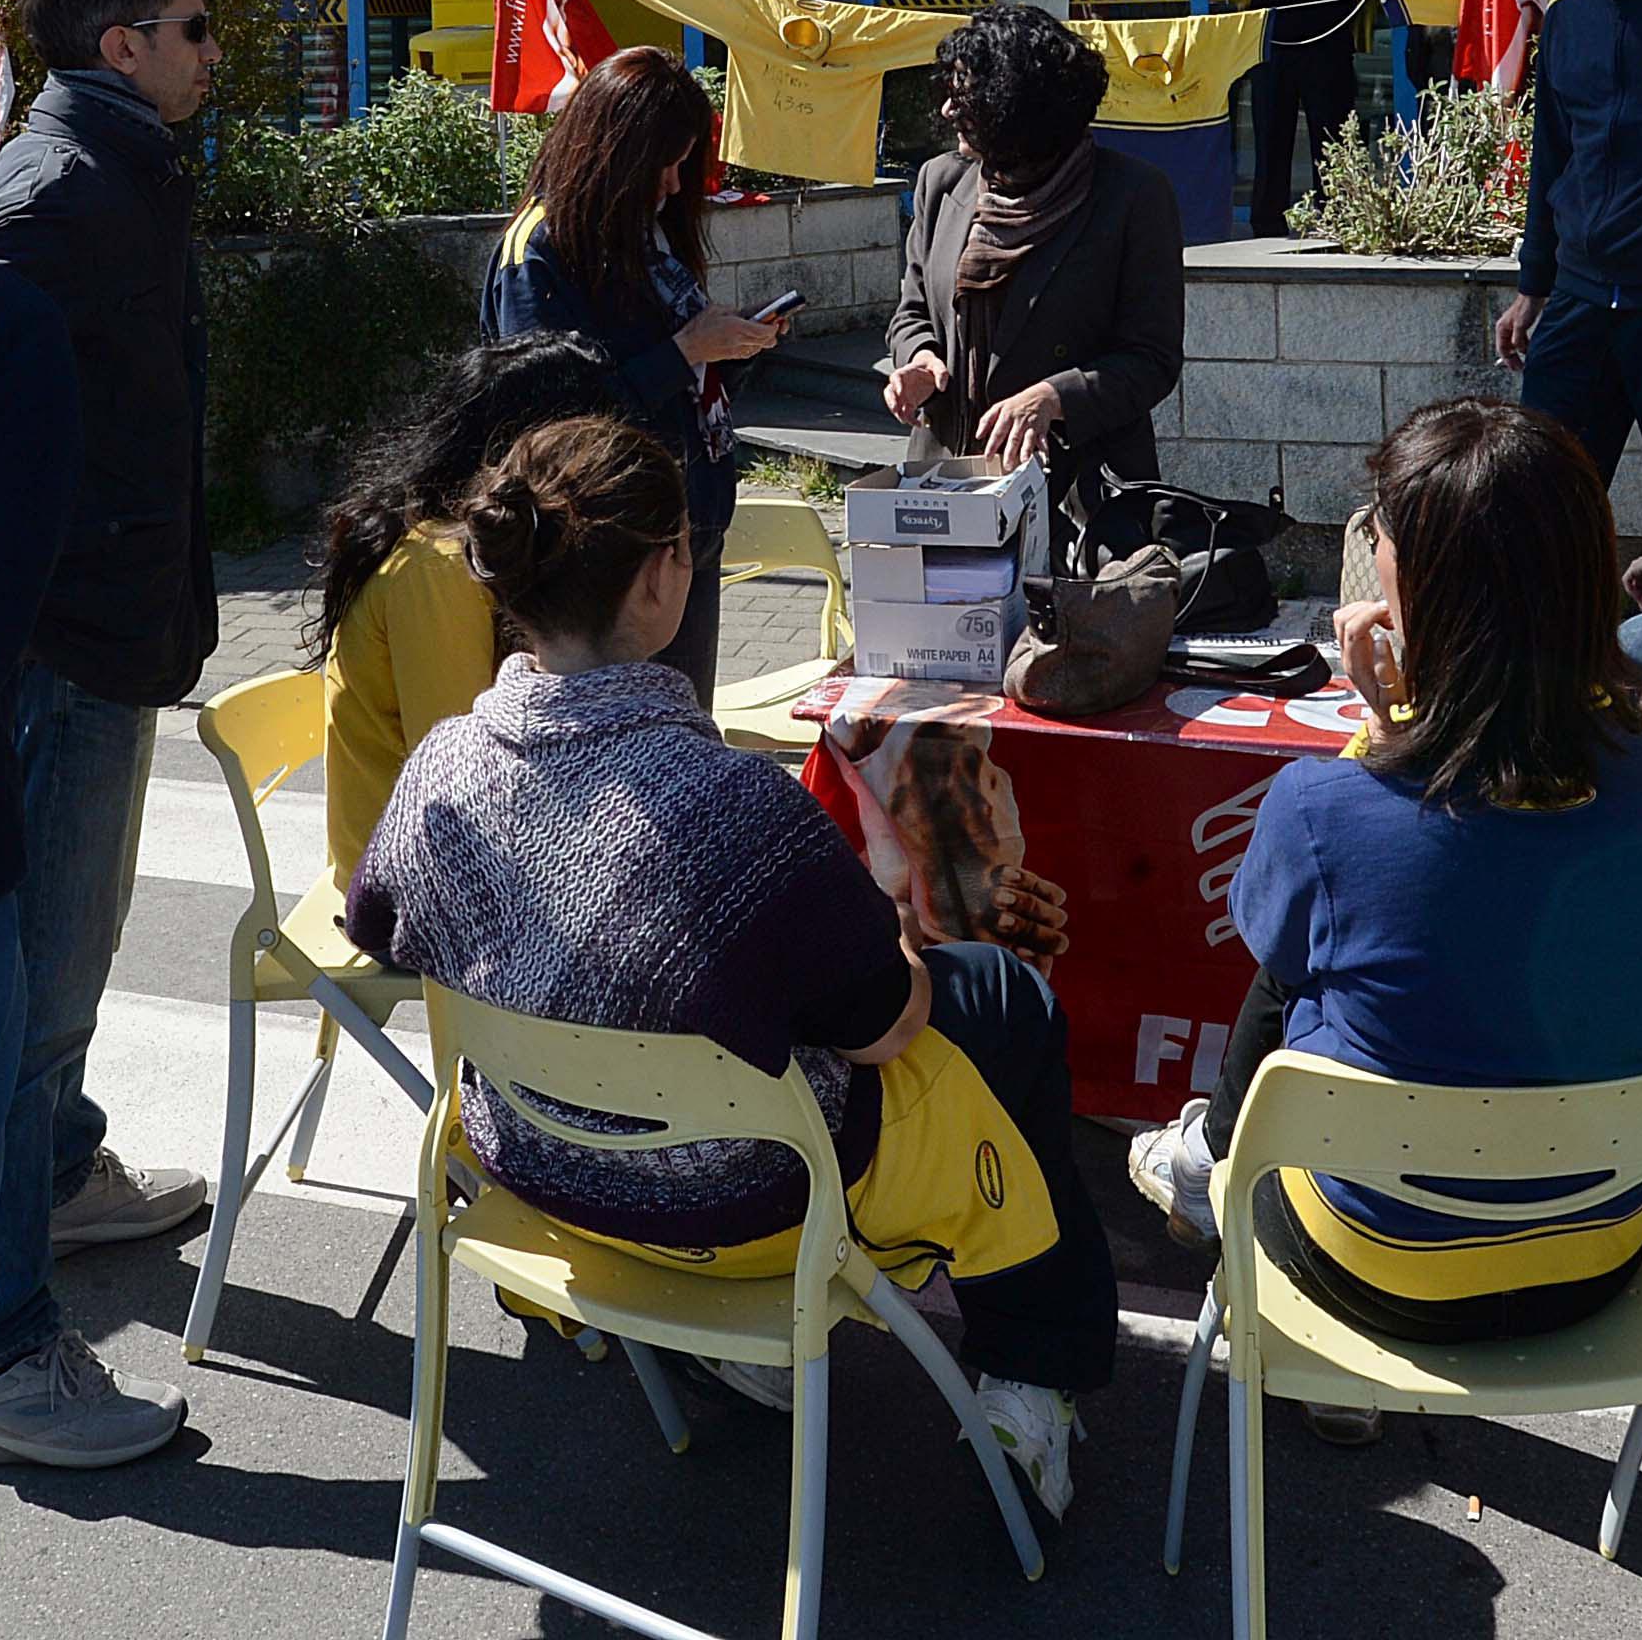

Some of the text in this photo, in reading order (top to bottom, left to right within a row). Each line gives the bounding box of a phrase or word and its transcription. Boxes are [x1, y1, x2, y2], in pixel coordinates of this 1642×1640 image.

[964, 616, 995, 638] 75g
[907, 648, 995, 663] WHITE PAPER A4
